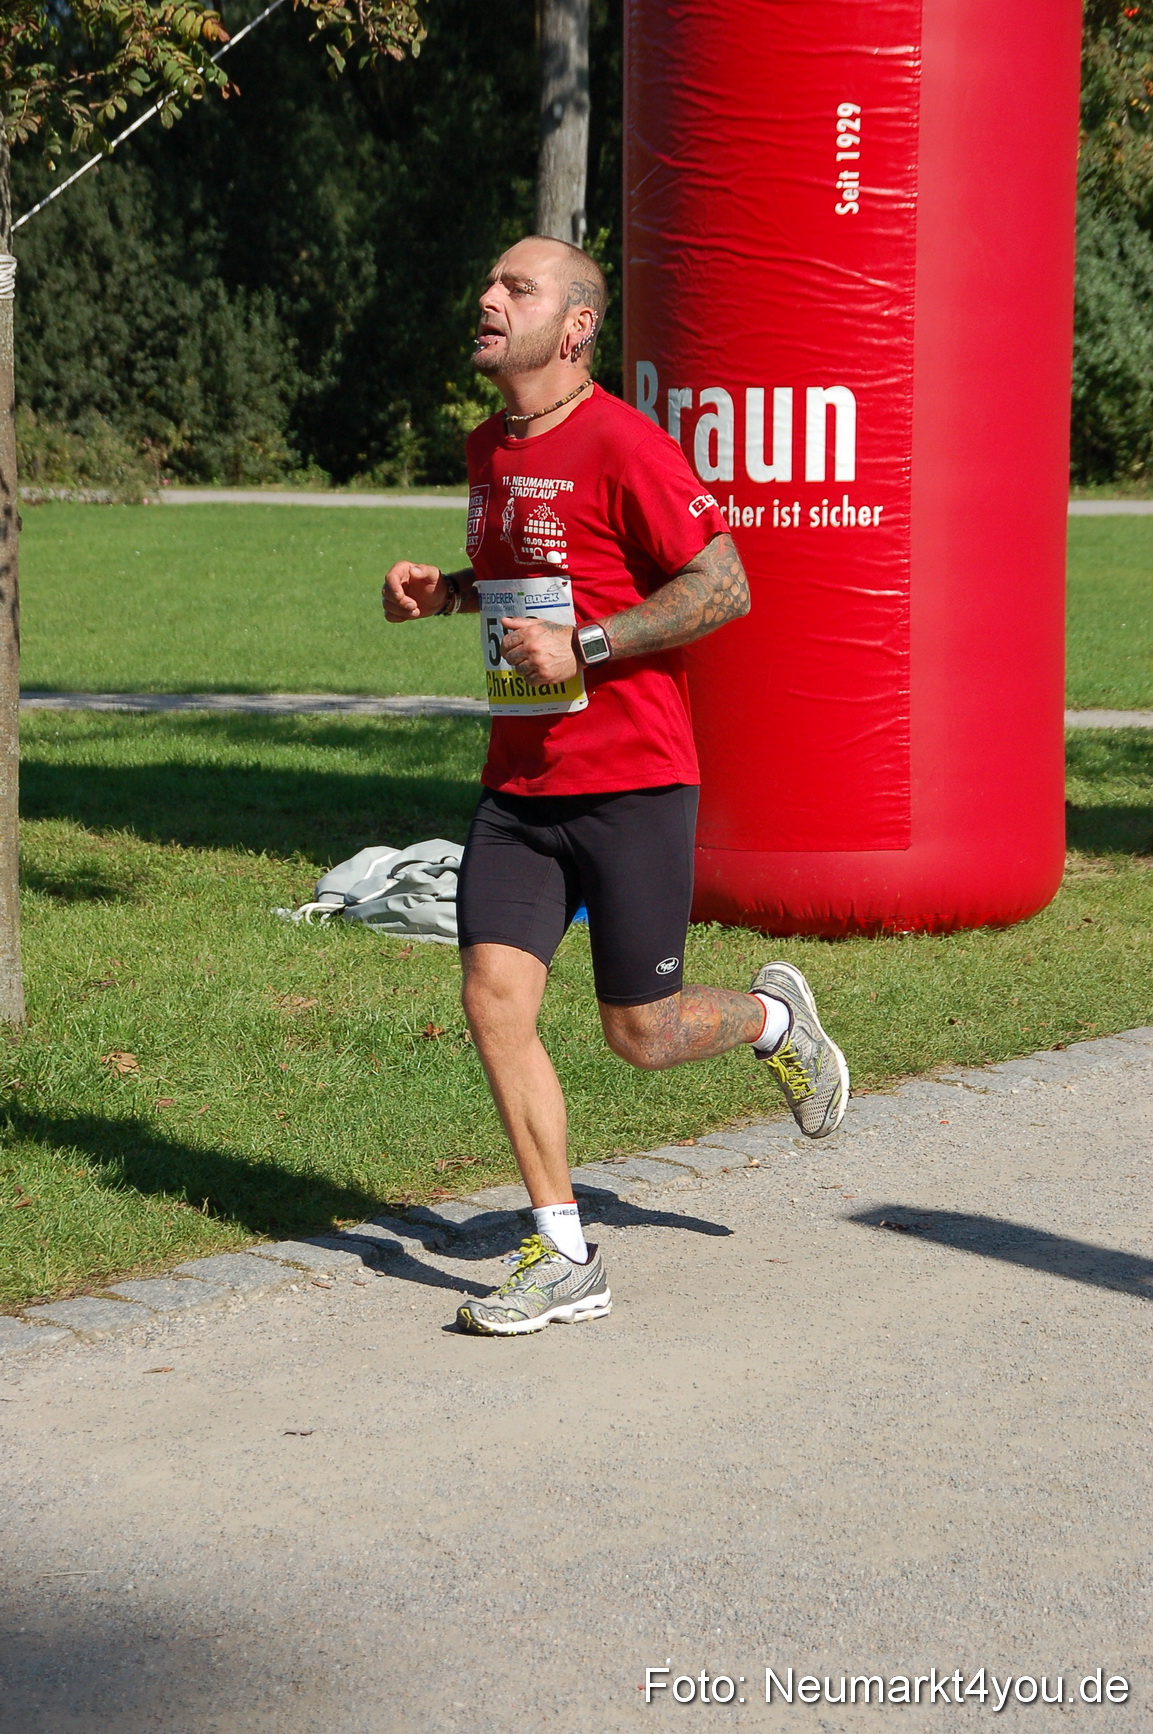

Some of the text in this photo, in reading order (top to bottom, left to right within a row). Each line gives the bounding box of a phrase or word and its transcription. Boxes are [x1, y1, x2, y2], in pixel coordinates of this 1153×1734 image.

[835, 102, 861, 215] Seit 1929
[502, 476, 574, 492] 11. NEUMARKTER
[510, 486, 558, 500] STADTLAUF
[773, 498, 801, 528] ist
[809, 494, 884, 528] sicher
[523, 537, 567, 548] 19.09.2010
